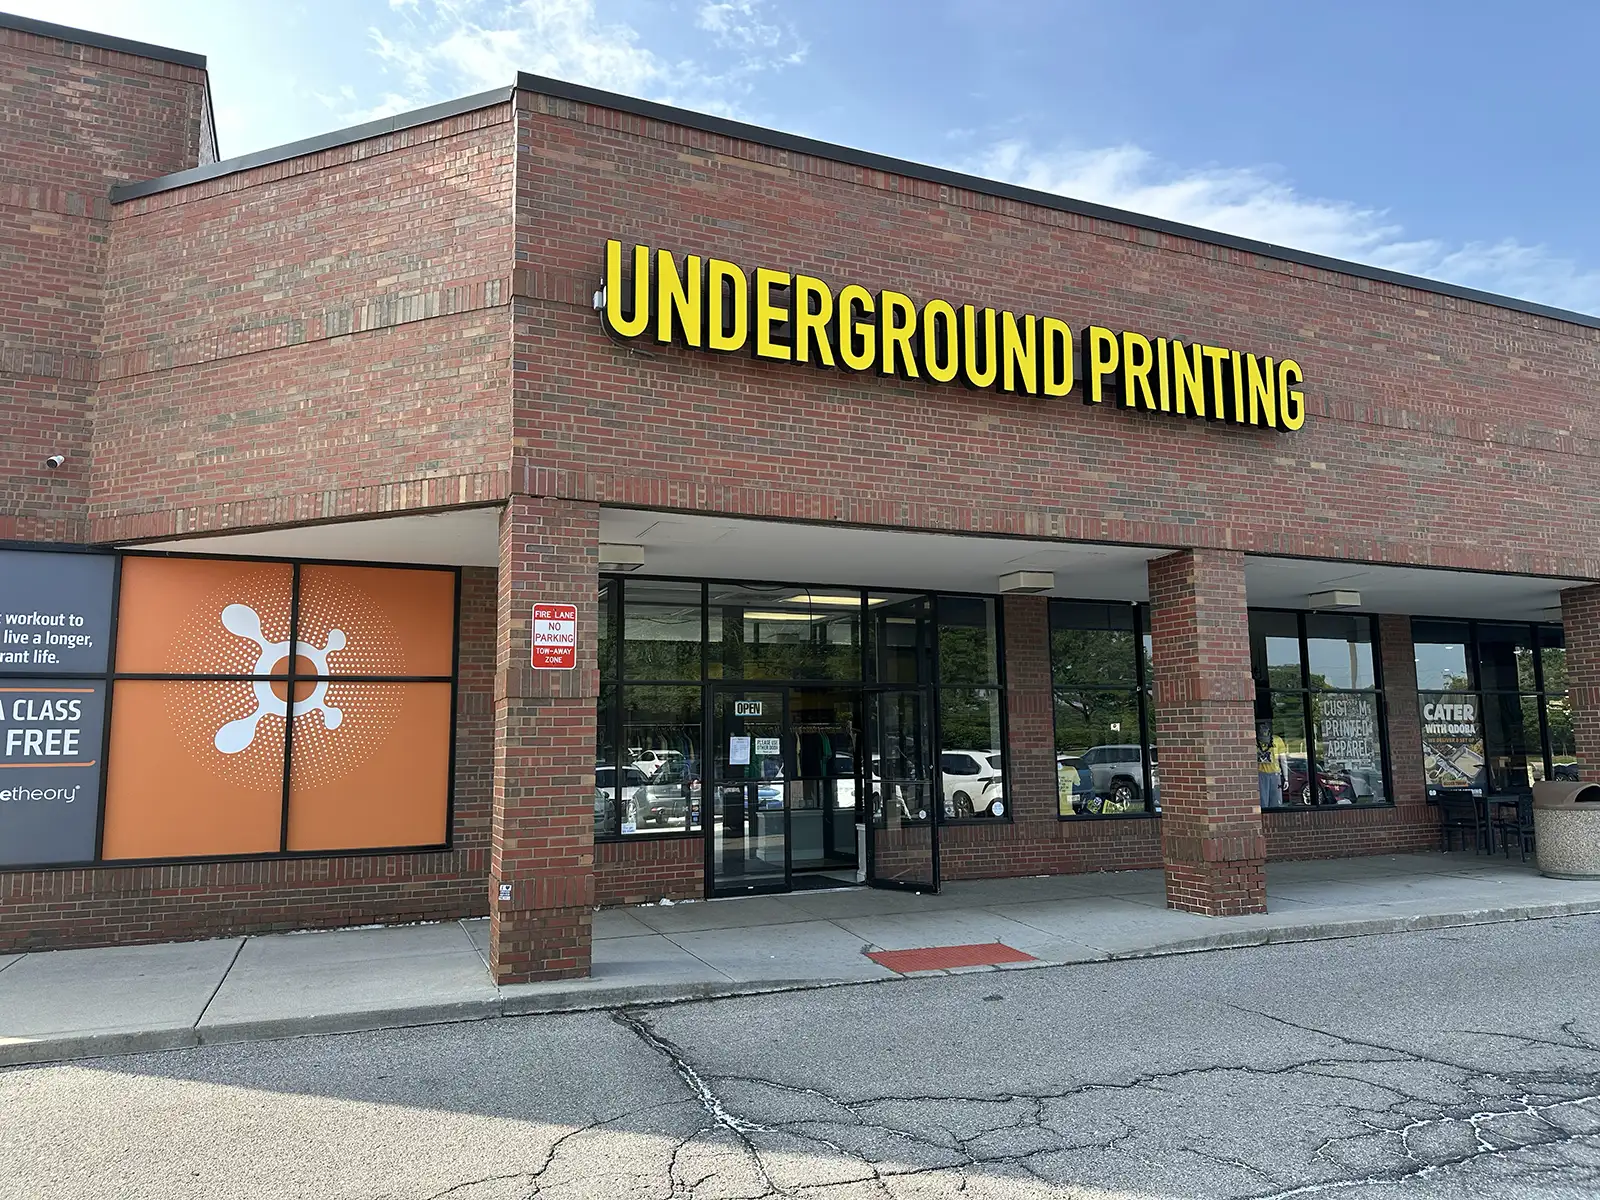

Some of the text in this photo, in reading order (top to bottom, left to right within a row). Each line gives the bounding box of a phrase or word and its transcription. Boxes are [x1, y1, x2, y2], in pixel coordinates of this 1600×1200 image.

[606, 239, 1306, 431] UNDERGROUND PRINTING
[5, 611, 65, 627] workout
[69, 613, 84, 627] to
[535, 610, 575, 619] FIRE LANE
[548, 622, 561, 631] NO
[3, 629, 93, 649] live a longer,
[535, 633, 574, 643] PARKING
[33, 649, 60, 664] life.
[535, 647, 572, 655] TOW-AWAY
[544, 656, 563, 664] ZONE
[12, 699, 82, 721] CLASS
[737, 702, 761, 715] OPEN
[1423, 703, 1474, 721] CATER
[1325, 719, 1370, 737] PRINTED
[1425, 723, 1476, 734] WITH QDOBA
[5, 729, 81, 756] FREE
[1327, 740, 1370, 758] APPAREL
